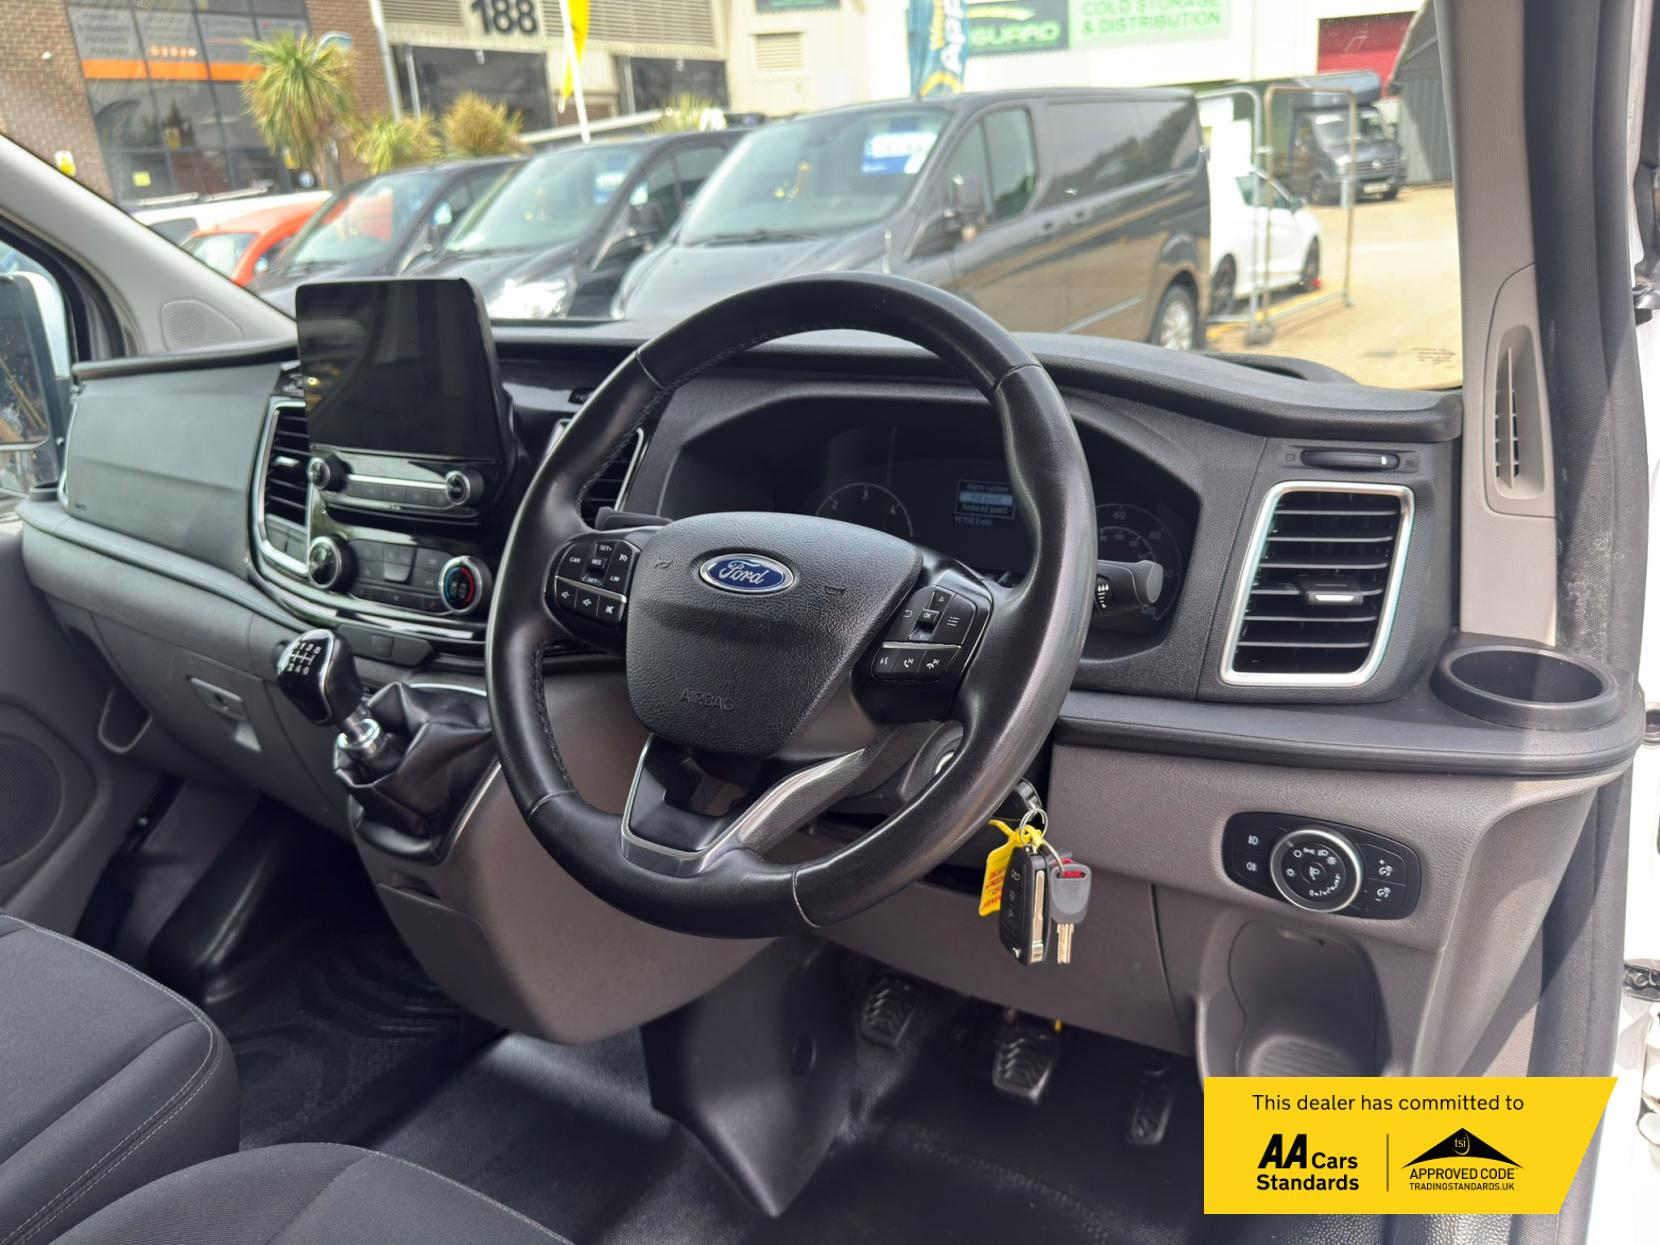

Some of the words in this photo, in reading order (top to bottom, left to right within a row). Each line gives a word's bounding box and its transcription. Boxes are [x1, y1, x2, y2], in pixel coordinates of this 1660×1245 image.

[470, 0, 537, 34] 188
[1099, 11, 1220, 33] DISTRIBUTION
[718, 560, 770, 585] Ford
